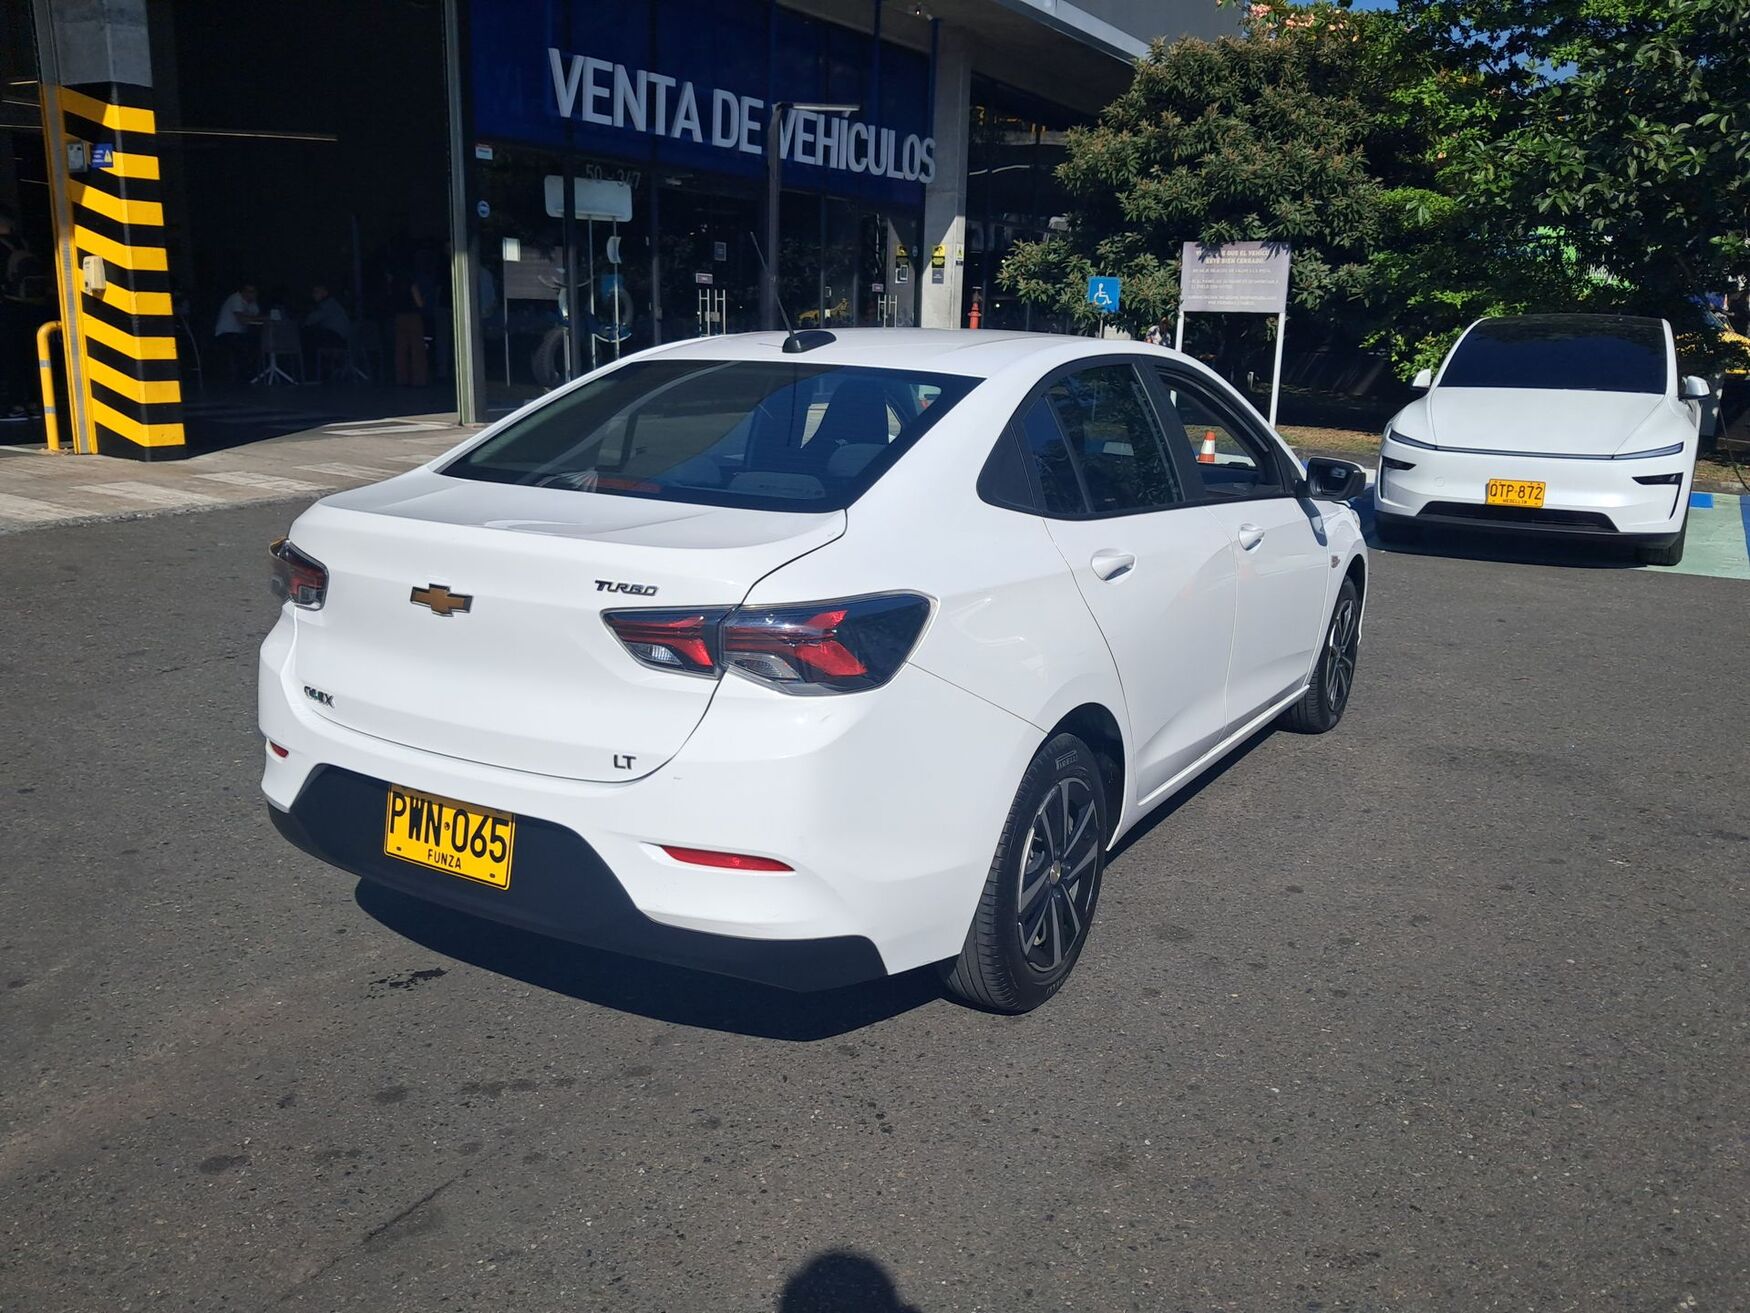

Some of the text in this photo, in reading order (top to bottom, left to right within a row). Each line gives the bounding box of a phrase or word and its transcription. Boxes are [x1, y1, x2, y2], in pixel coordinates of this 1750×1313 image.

[548, 47, 702, 142] VENTA
[712, 88, 764, 154] DE
[594, 579, 660, 597] TURBO
[613, 754, 637, 770] LT
[427, 848, 462, 870] FUNZA
